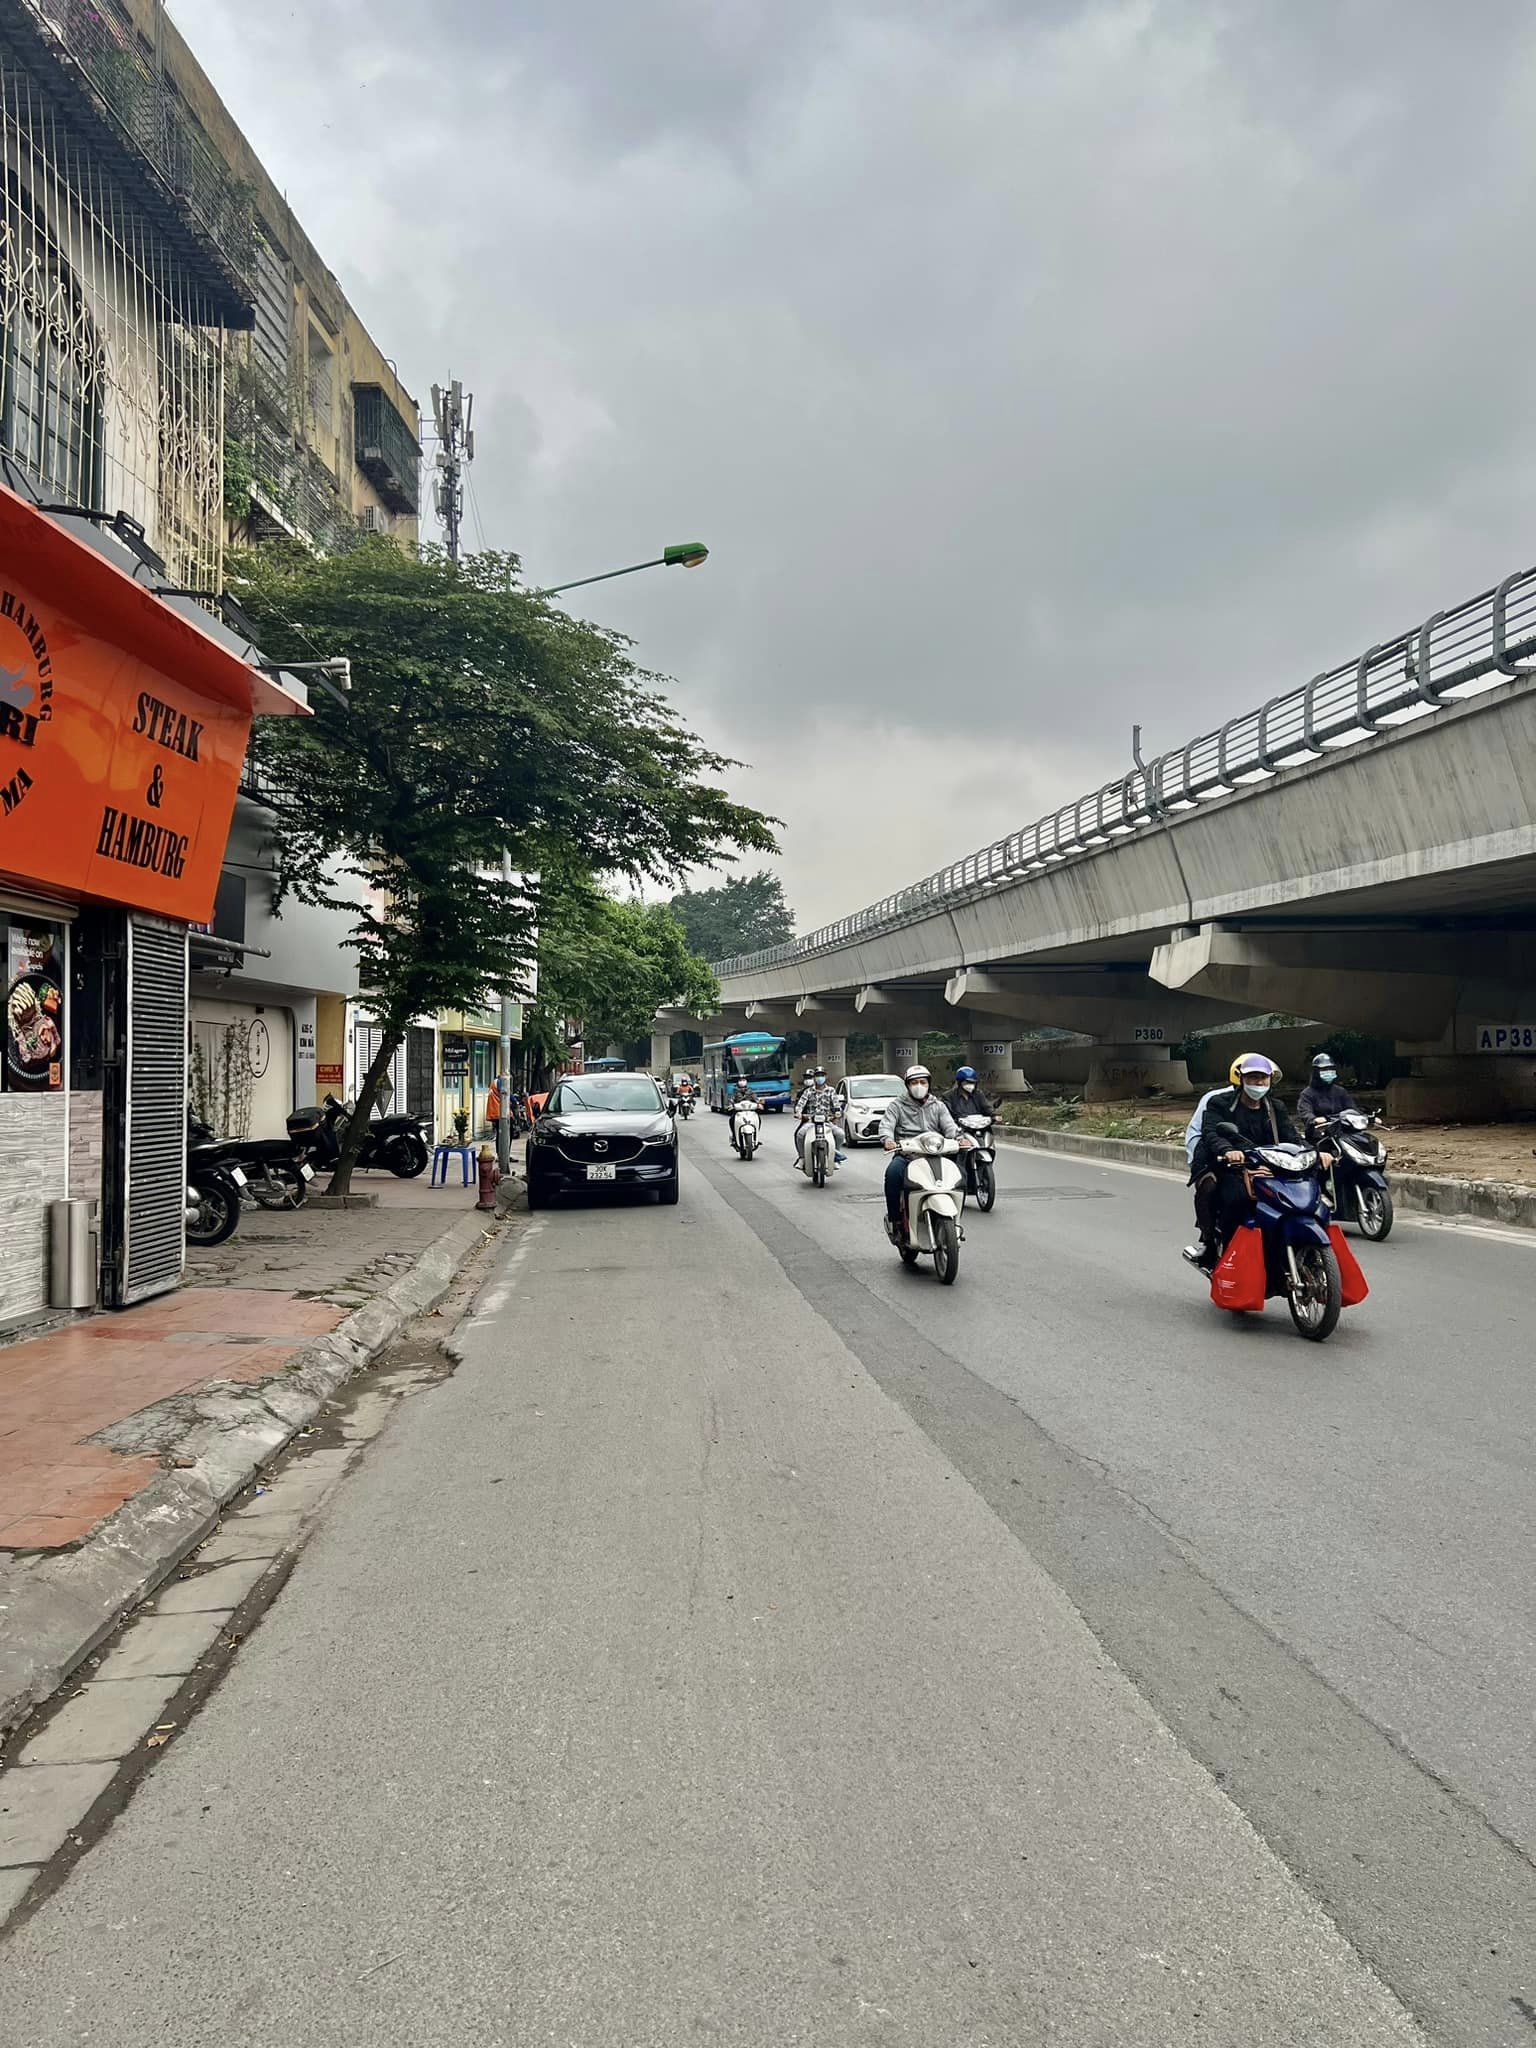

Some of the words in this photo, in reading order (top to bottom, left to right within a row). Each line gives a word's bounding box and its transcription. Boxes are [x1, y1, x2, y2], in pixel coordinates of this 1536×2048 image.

[0, 590, 53, 721] HAMBURG
[132, 692, 204, 762] STEAK
[146, 764, 163, 808] &
[96, 806, 189, 879] HAMBURG
[983, 1045, 1003, 1054] P379
[1135, 1029, 1163, 1040] P380
[1481, 1028, 1536, 1048] AP38
